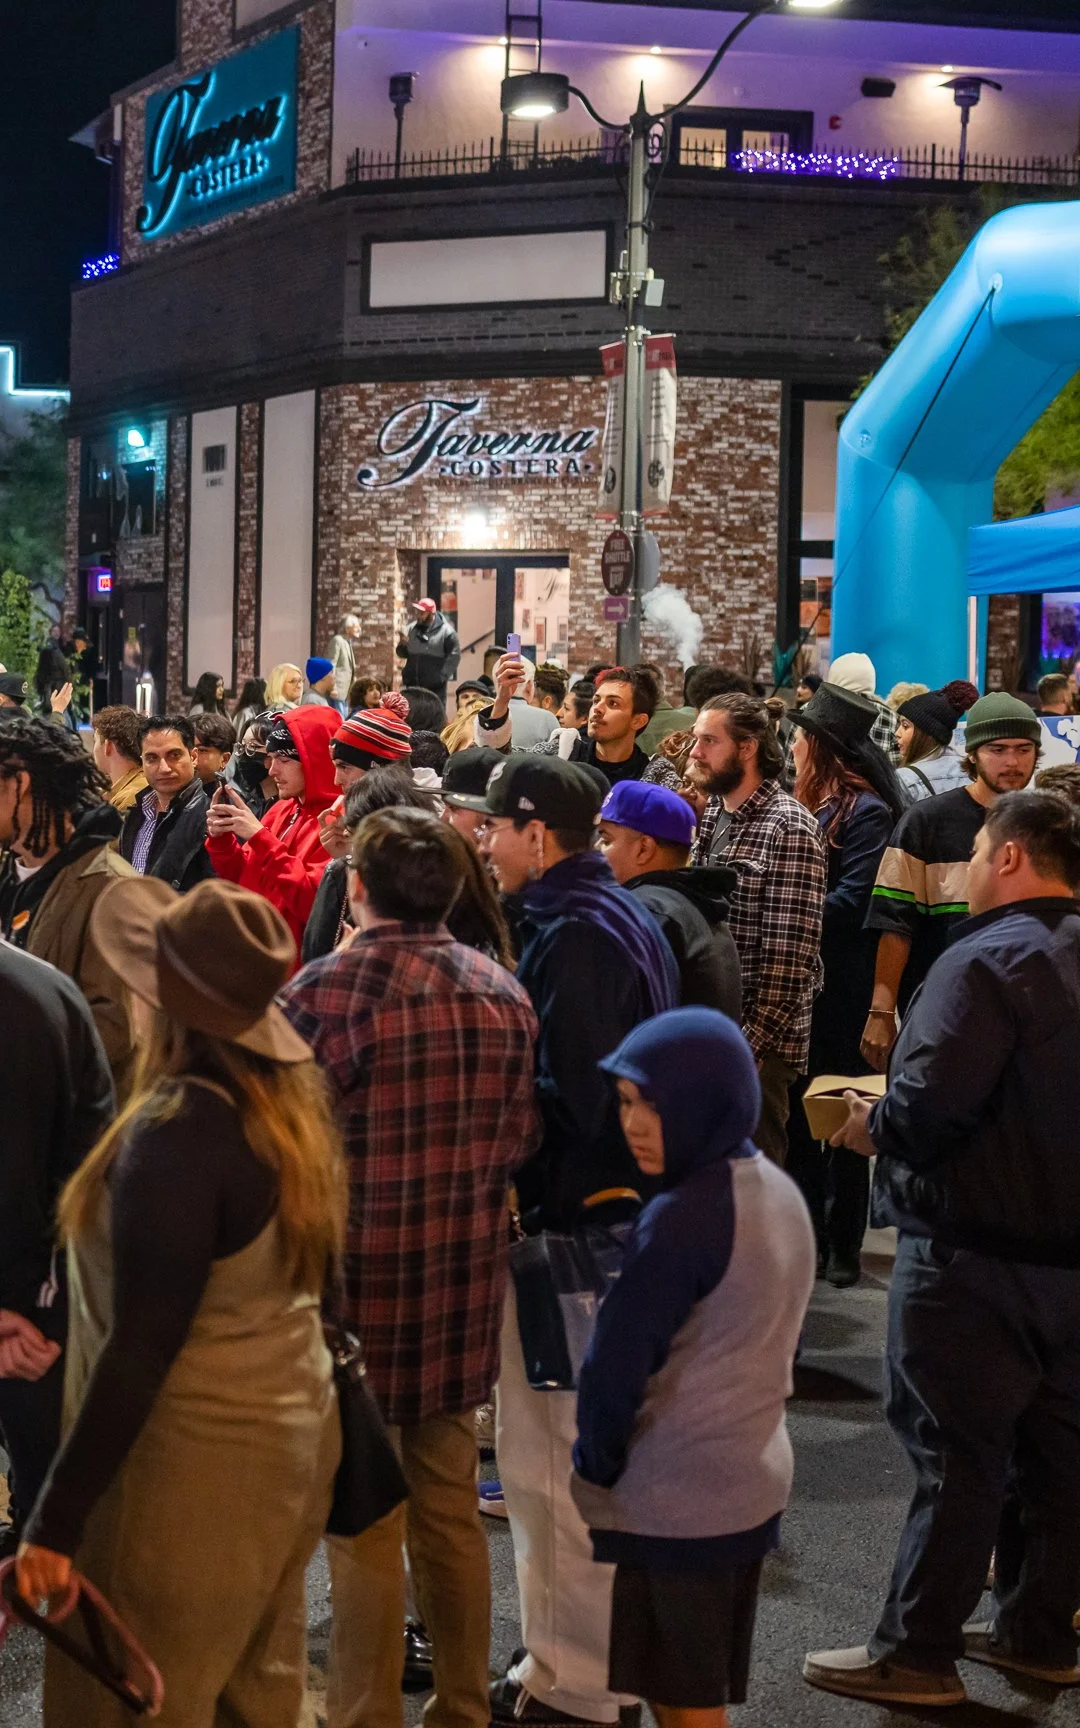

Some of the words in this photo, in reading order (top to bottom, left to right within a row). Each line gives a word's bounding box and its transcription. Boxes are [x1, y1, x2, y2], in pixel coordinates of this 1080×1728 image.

[190, 152, 264, 198] COSTERA
[358, 399, 598, 487] Taverna
[450, 458, 581, 476] COSTERA
[604, 551, 631, 563] SHUTTLE
